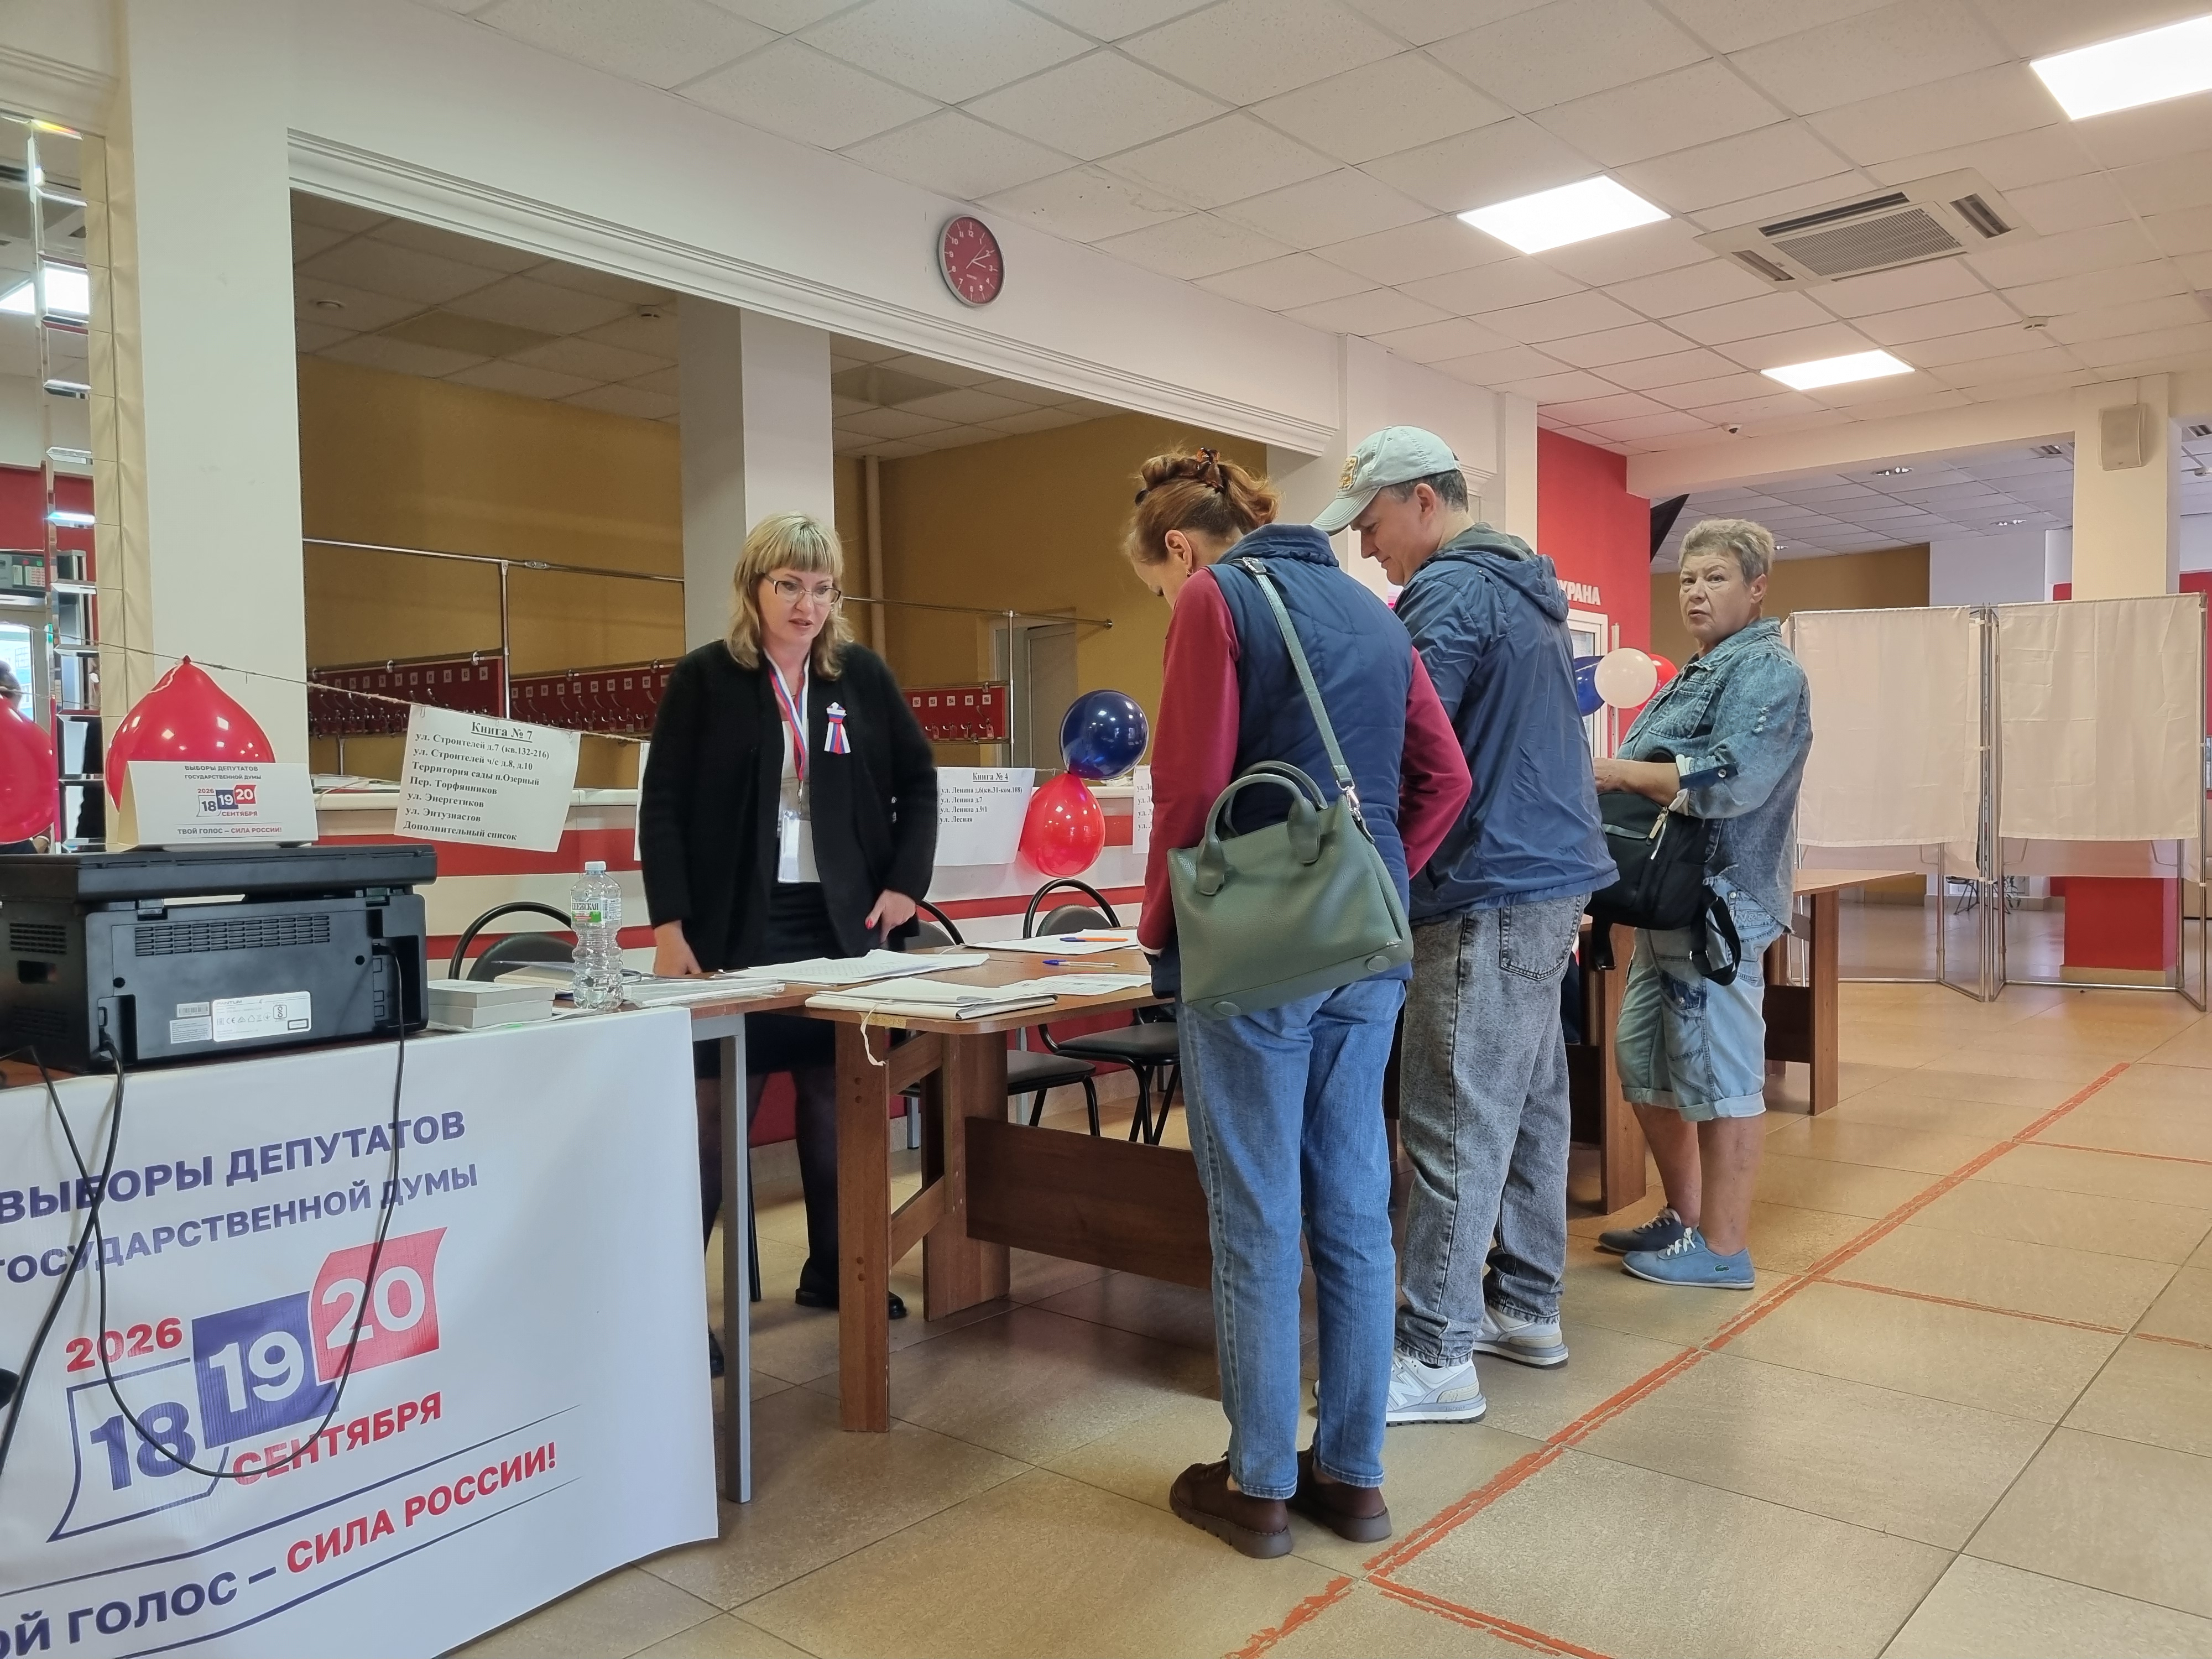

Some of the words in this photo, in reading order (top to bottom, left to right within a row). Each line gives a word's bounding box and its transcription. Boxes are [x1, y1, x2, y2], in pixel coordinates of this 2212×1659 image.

[471, 721, 508, 737] Книга
[510, 728, 524, 739] №
[527, 731, 533, 740] 7
[415, 733, 430, 742] ул.
[433, 734, 485, 749] Строителей
[487, 744, 499, 752] д.7
[413, 748, 428, 757] ул.
[431, 749, 484, 764] Строителей
[487, 759, 498, 767] ч/с
[500, 760, 515, 768] д.8,
[517, 762, 533, 770] д.10
[412, 761, 469, 776] Территория
[471, 771, 493, 780] сады
[972, 772, 994, 780] Книга
[995, 772, 1003, 780] №
[235, 789, 254, 800] 20
[410, 776, 431, 787] Пер.
[435, 779, 497, 795] Торфянников
[201, 801, 217, 812] 18
[217, 794, 234, 806] 19
[407, 792, 422, 801] ул.
[425, 793, 484, 808] Энергетиков
[405, 807, 420, 816] ул.
[423, 808, 481, 822] Энтузиастов
[403, 821, 485, 837] Дополнительный
[487, 831, 518, 841] список
[0, 1156, 213, 1225] ВЫБОРЫ
[226, 1110, 466, 1187] ДЕПУТАТОВ
[0, 1179, 372, 1284] ОСУДАРСТВЕННОЙ
[380, 1164, 478, 1211] ДУМЫ
[322, 1266, 426, 1349] 20
[65, 1317, 184, 1373] 2026
[208, 1332, 305, 1413] 19
[90, 1401, 196, 1492] 18
[232, 1391, 442, 1486] СЕНТЯБРЯ
[0, 1610, 51, 1659] Й
[68, 1571, 238, 1644] ГОЛОС
[285, 1508, 396, 1574] СИЛА
[404, 1442, 556, 1527] РОССИИ!
